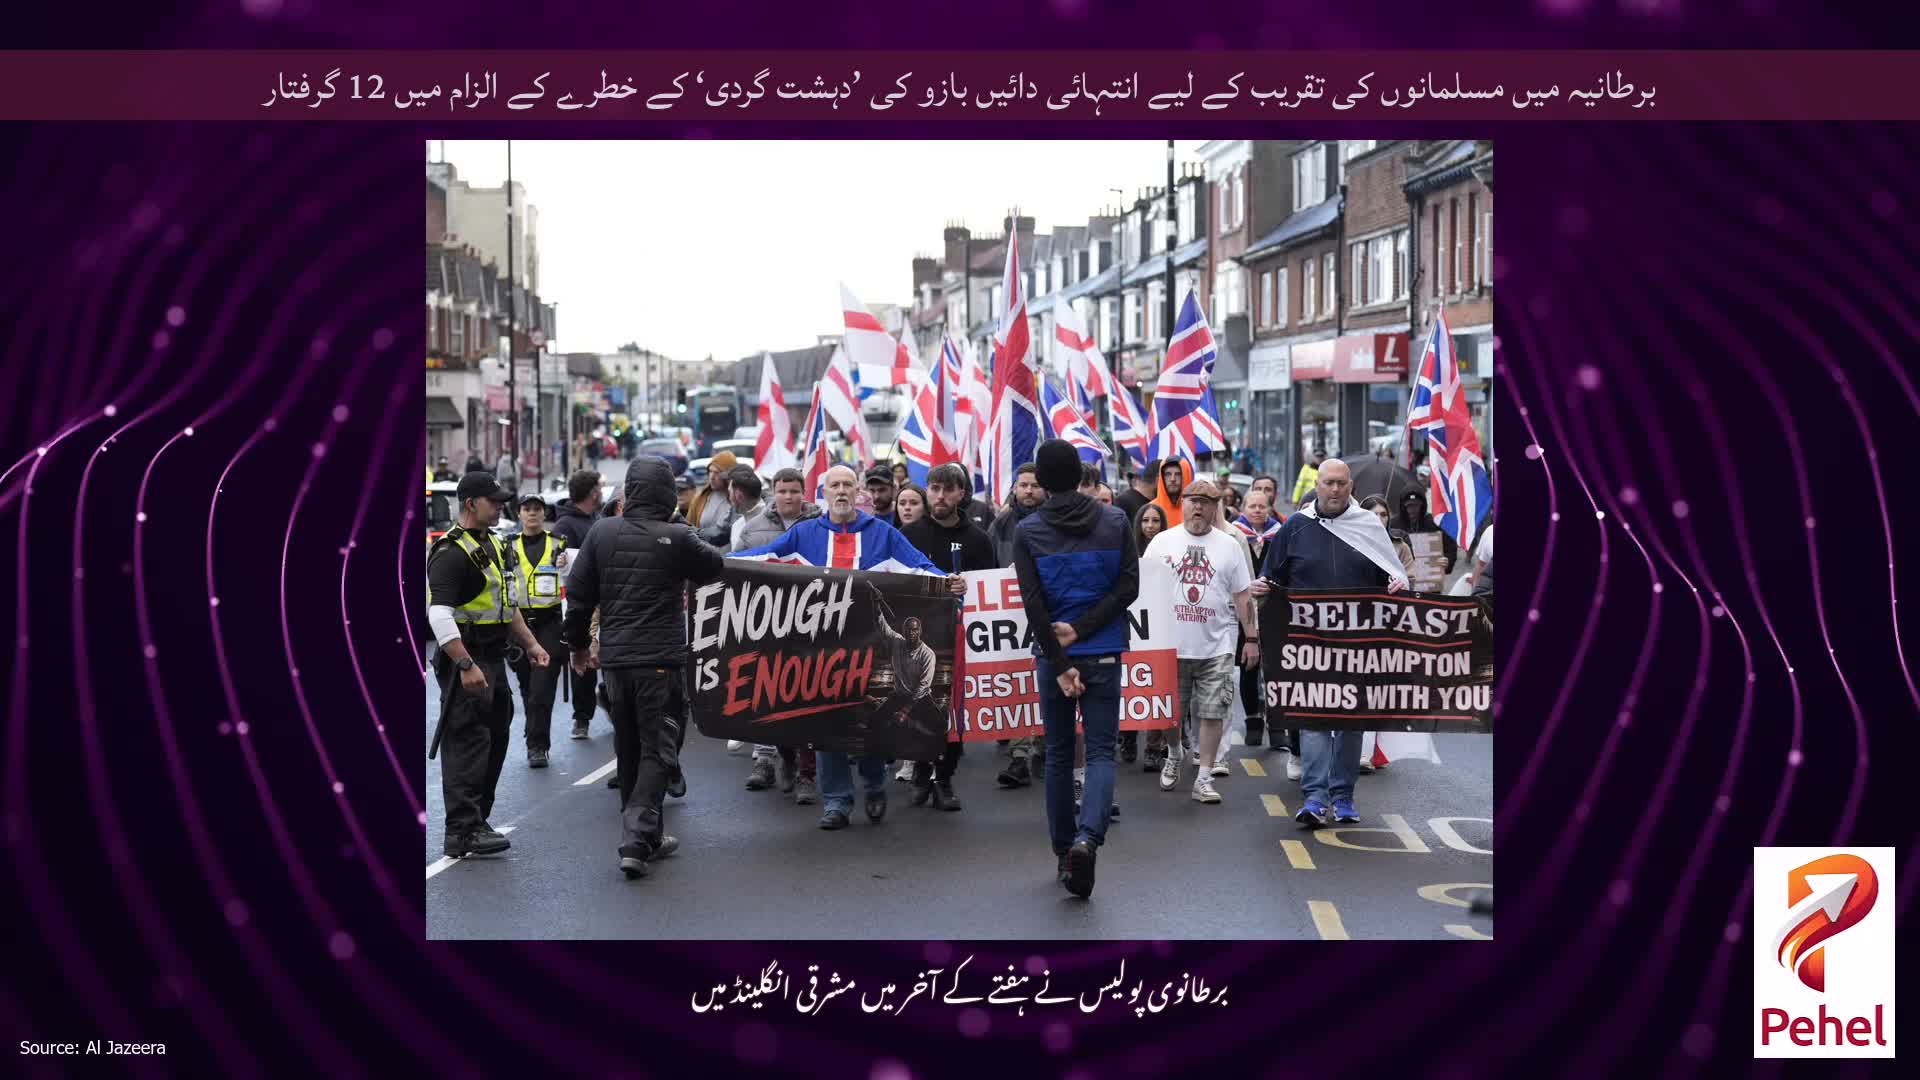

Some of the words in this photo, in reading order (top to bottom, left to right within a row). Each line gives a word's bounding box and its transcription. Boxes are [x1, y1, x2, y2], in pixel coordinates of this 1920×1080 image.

[691, 575, 854, 652] ENOUGH
[1176, 613, 1208, 624] PATRIOTS
[1289, 601, 1478, 638] BELFAST
[1281, 644, 1471, 677] SOUTHAMPTON
[722, 645, 874, 717] ENOUGH
[1266, 681, 1358, 710] STANDS
[1366, 685, 1429, 710] WITH
[1437, 685, 1490, 711] YOU
